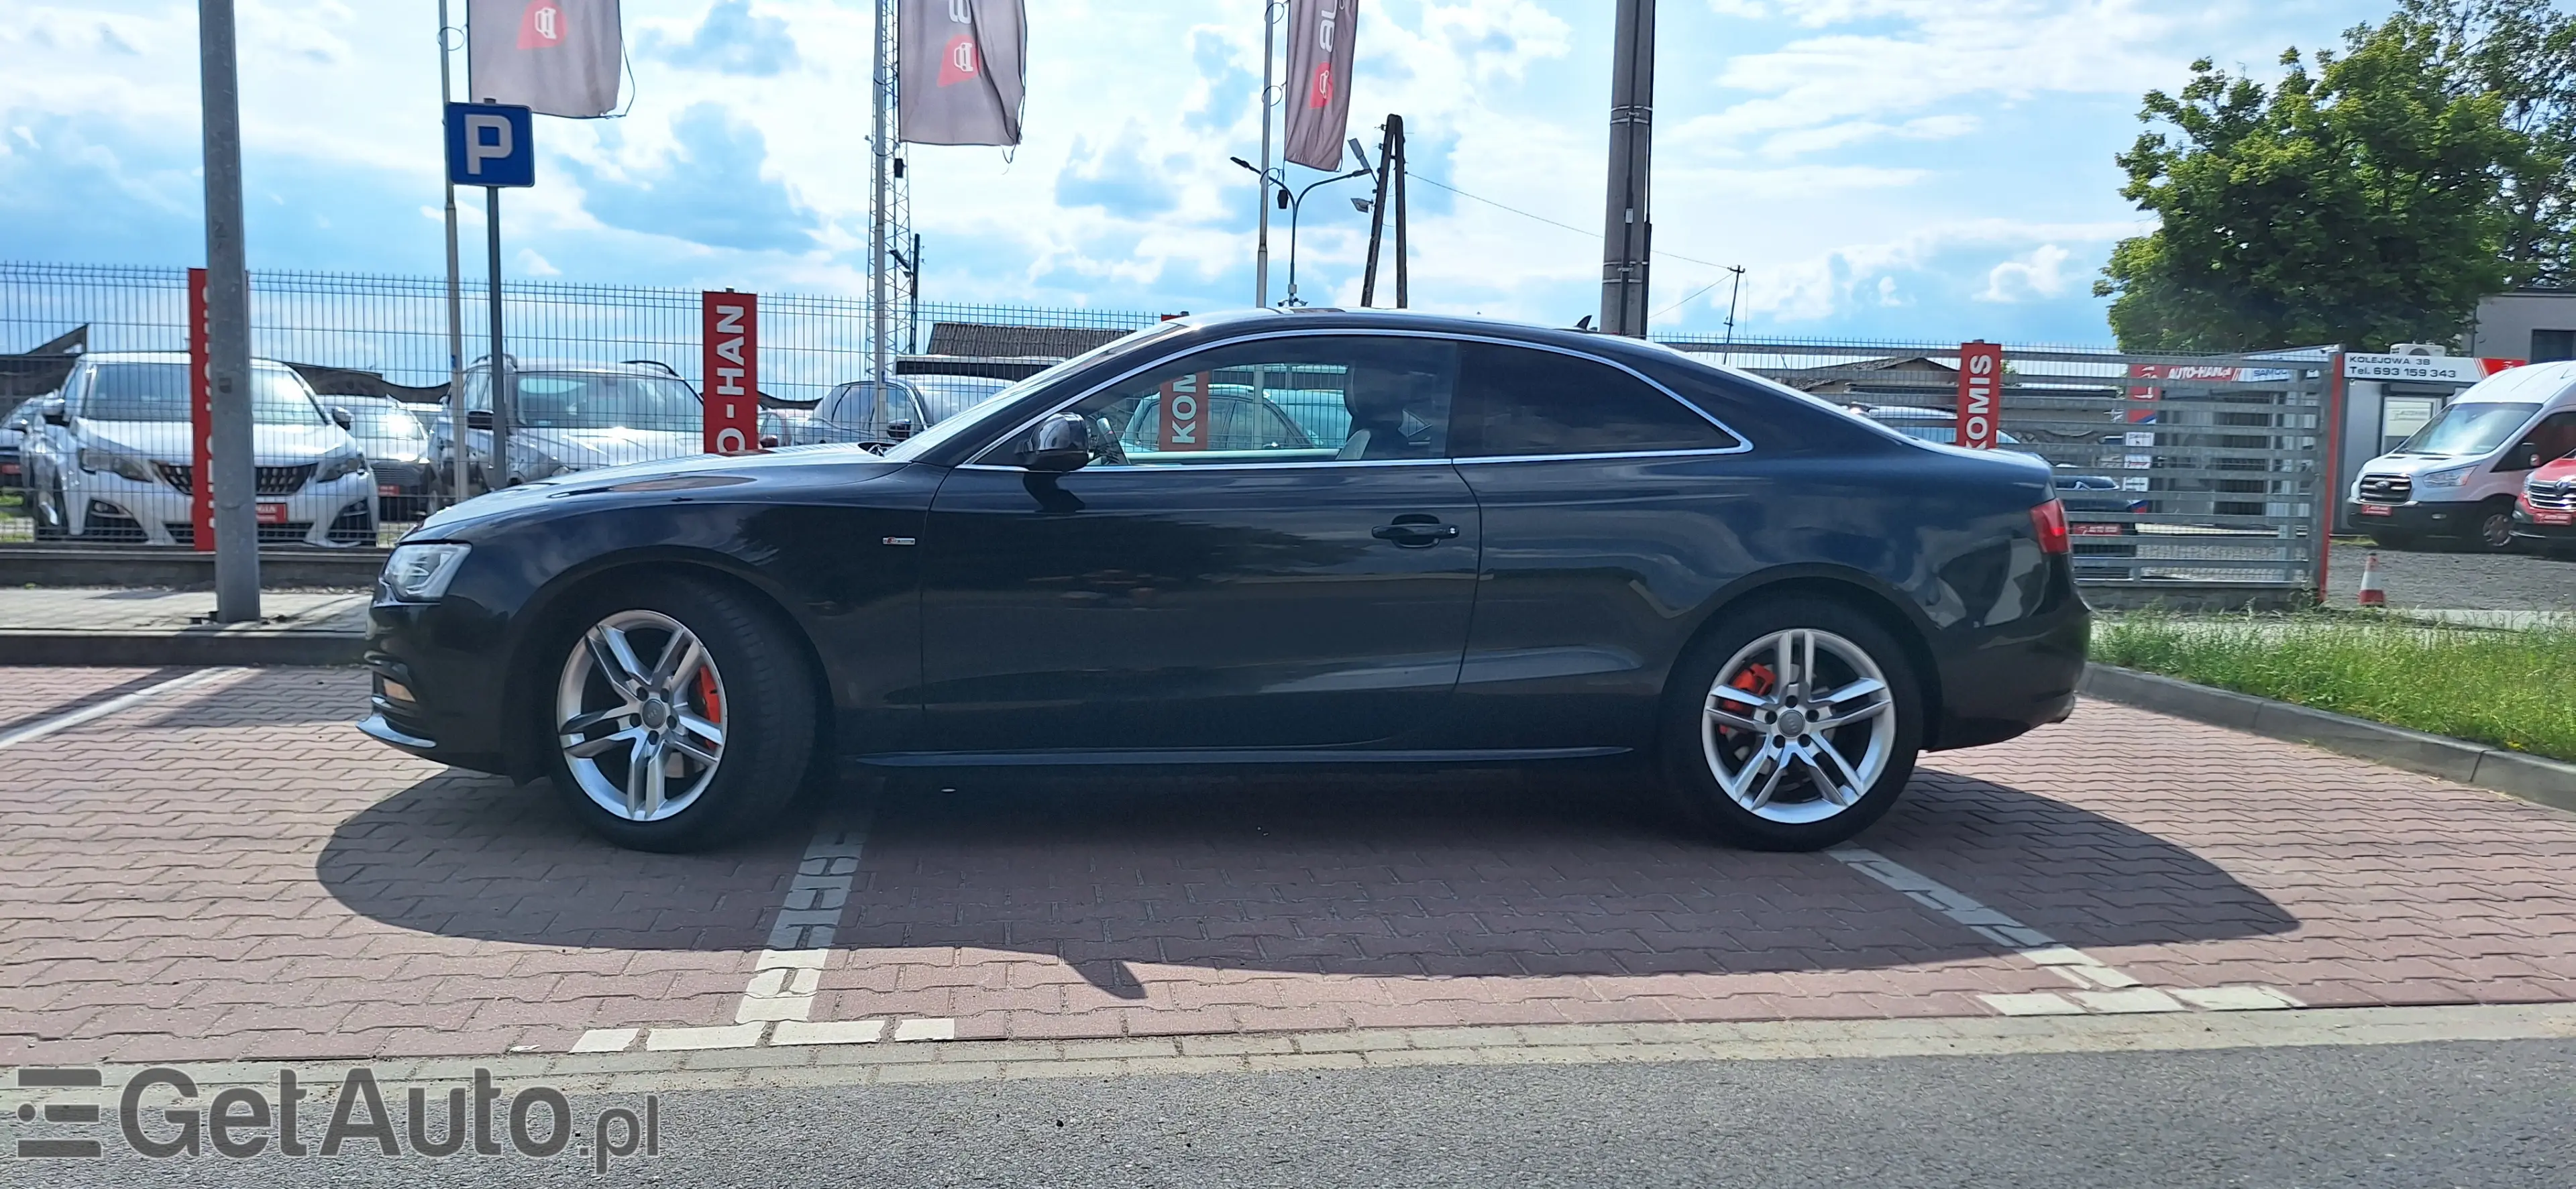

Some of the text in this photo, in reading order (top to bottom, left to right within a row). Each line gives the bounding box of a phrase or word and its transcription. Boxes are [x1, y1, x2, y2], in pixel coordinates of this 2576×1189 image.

[465, 114, 513, 174] P
[2349, 356, 2410, 365] KOLEJOWA
[2350, 366, 2456, 378] Tel. 693 159 343
